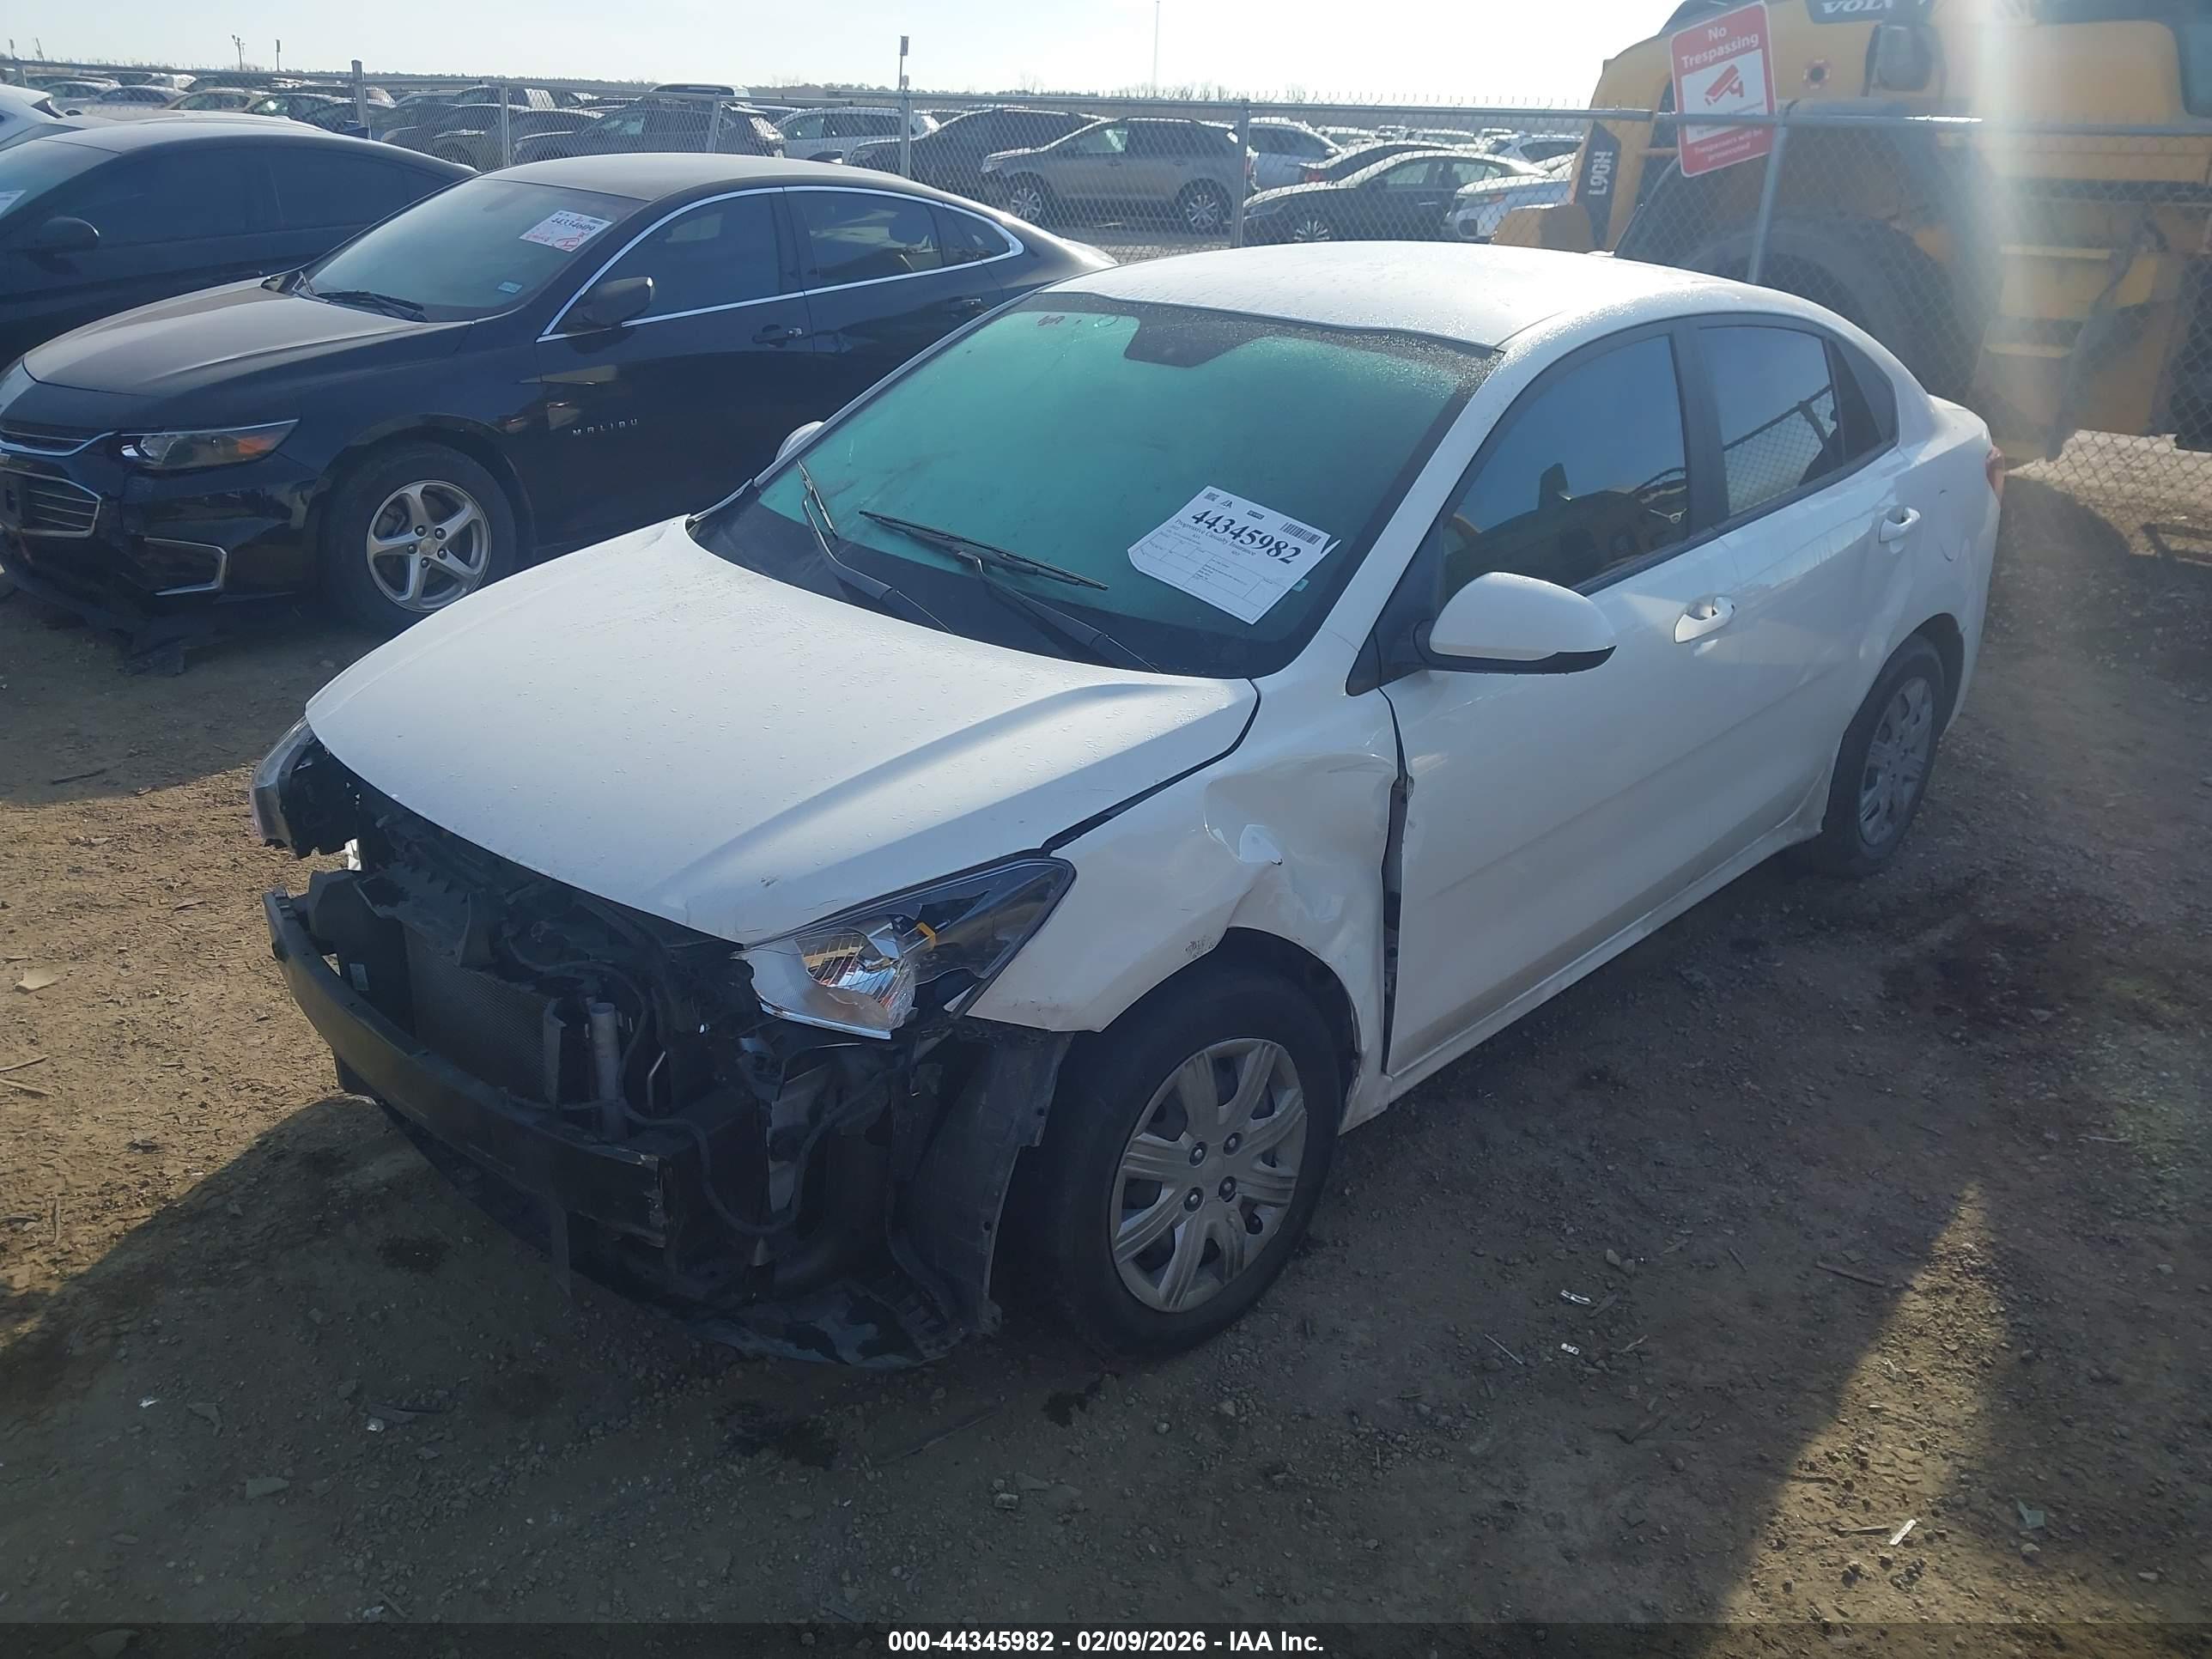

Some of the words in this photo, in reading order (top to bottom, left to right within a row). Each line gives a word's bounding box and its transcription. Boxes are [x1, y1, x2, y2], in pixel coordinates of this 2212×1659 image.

[1681, 33, 1759, 69] Trespassing
[1708, 27, 1727, 41] No
[1588, 151, 1613, 196] L90H
[573, 418, 638, 436] MALIBU
[1191, 510, 1302, 564] 44345982
